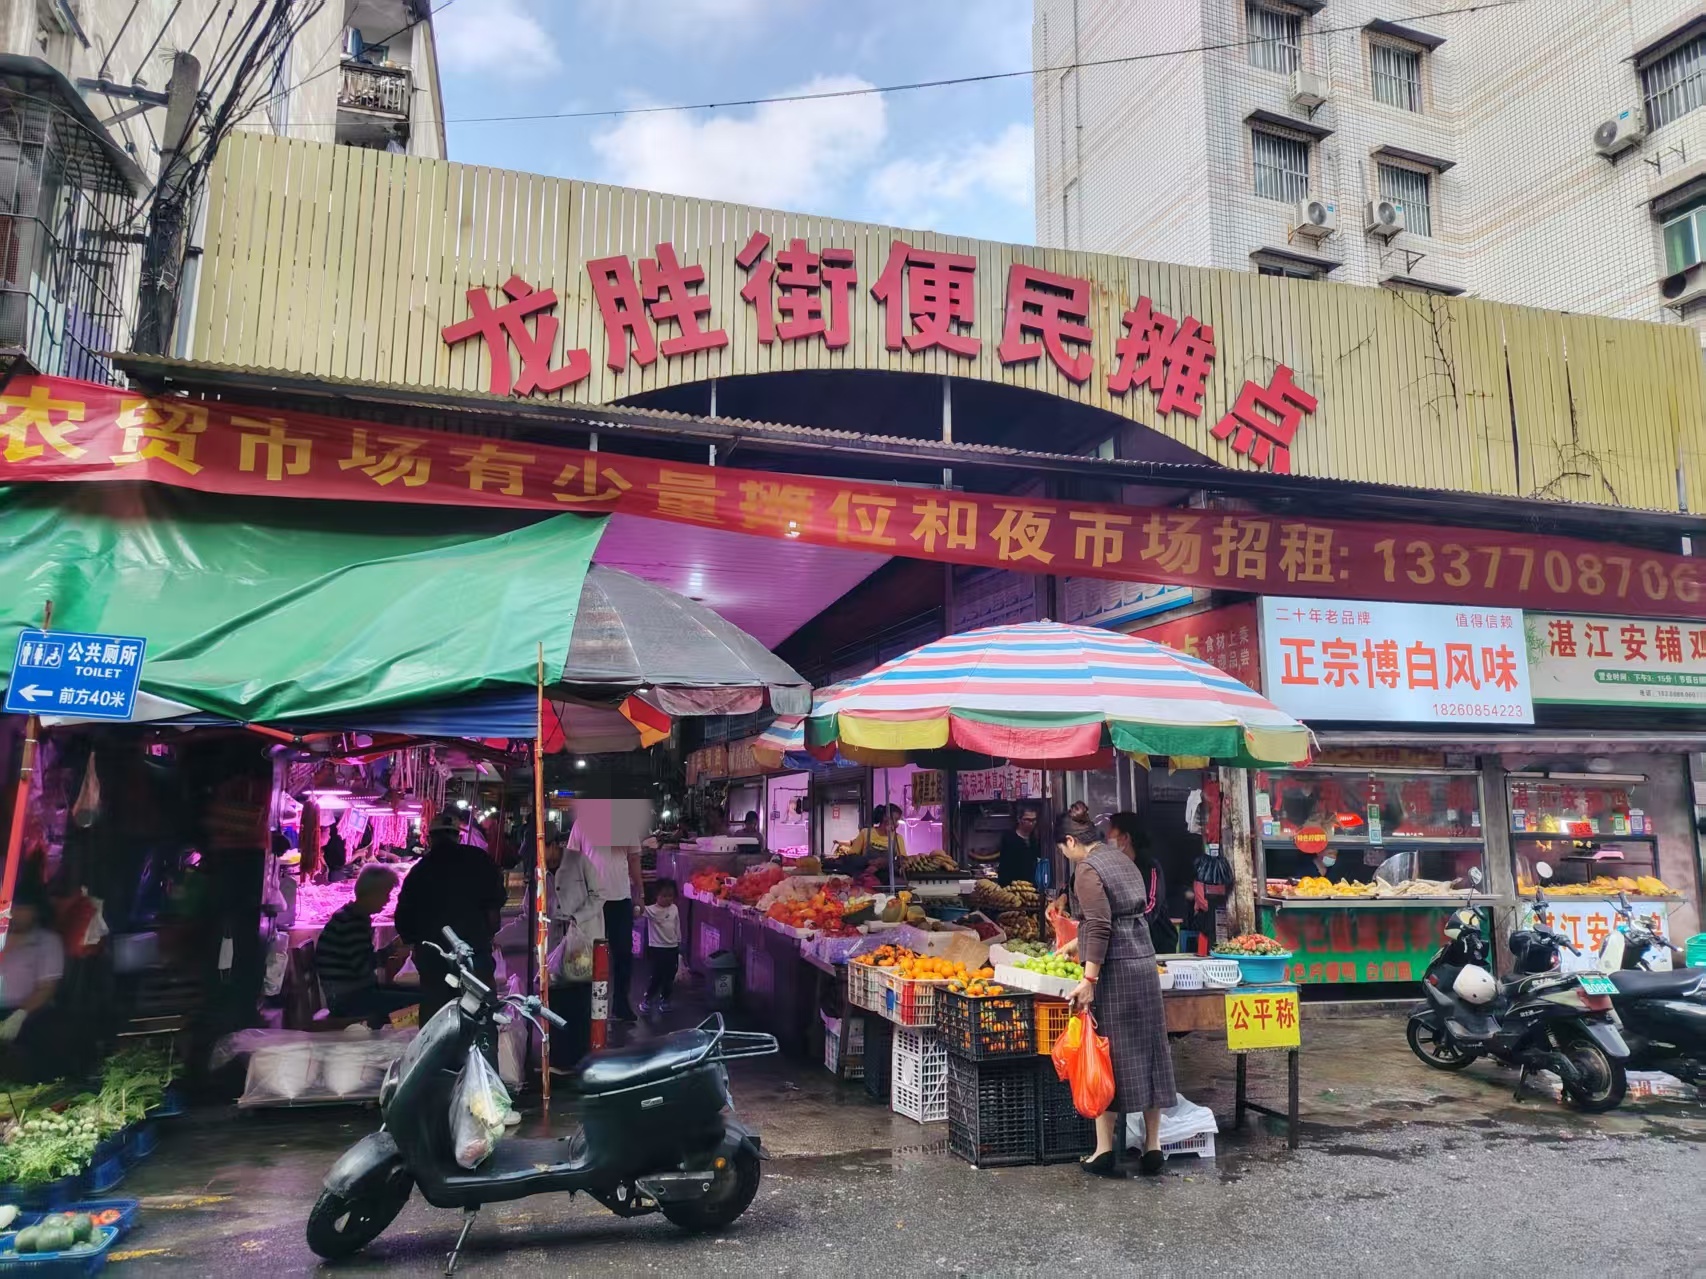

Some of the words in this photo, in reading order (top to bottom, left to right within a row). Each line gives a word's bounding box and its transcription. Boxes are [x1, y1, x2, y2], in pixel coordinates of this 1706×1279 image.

[441, 230, 1318, 475] 龙胜街便民摊点
[1276, 608, 1371, 625] 二十年老品牌
[1455, 613, 1513, 629] 值得信赖
[68, 642, 138, 667] 公共厕所
[1279, 637, 1518, 692] 正宗博白风味
[75, 665, 122, 679] TOILET
[59, 687, 126, 708] 前方40米
[1433, 703, 1522, 717] 18260854223
[1231, 998, 1296, 1031] 公平称
